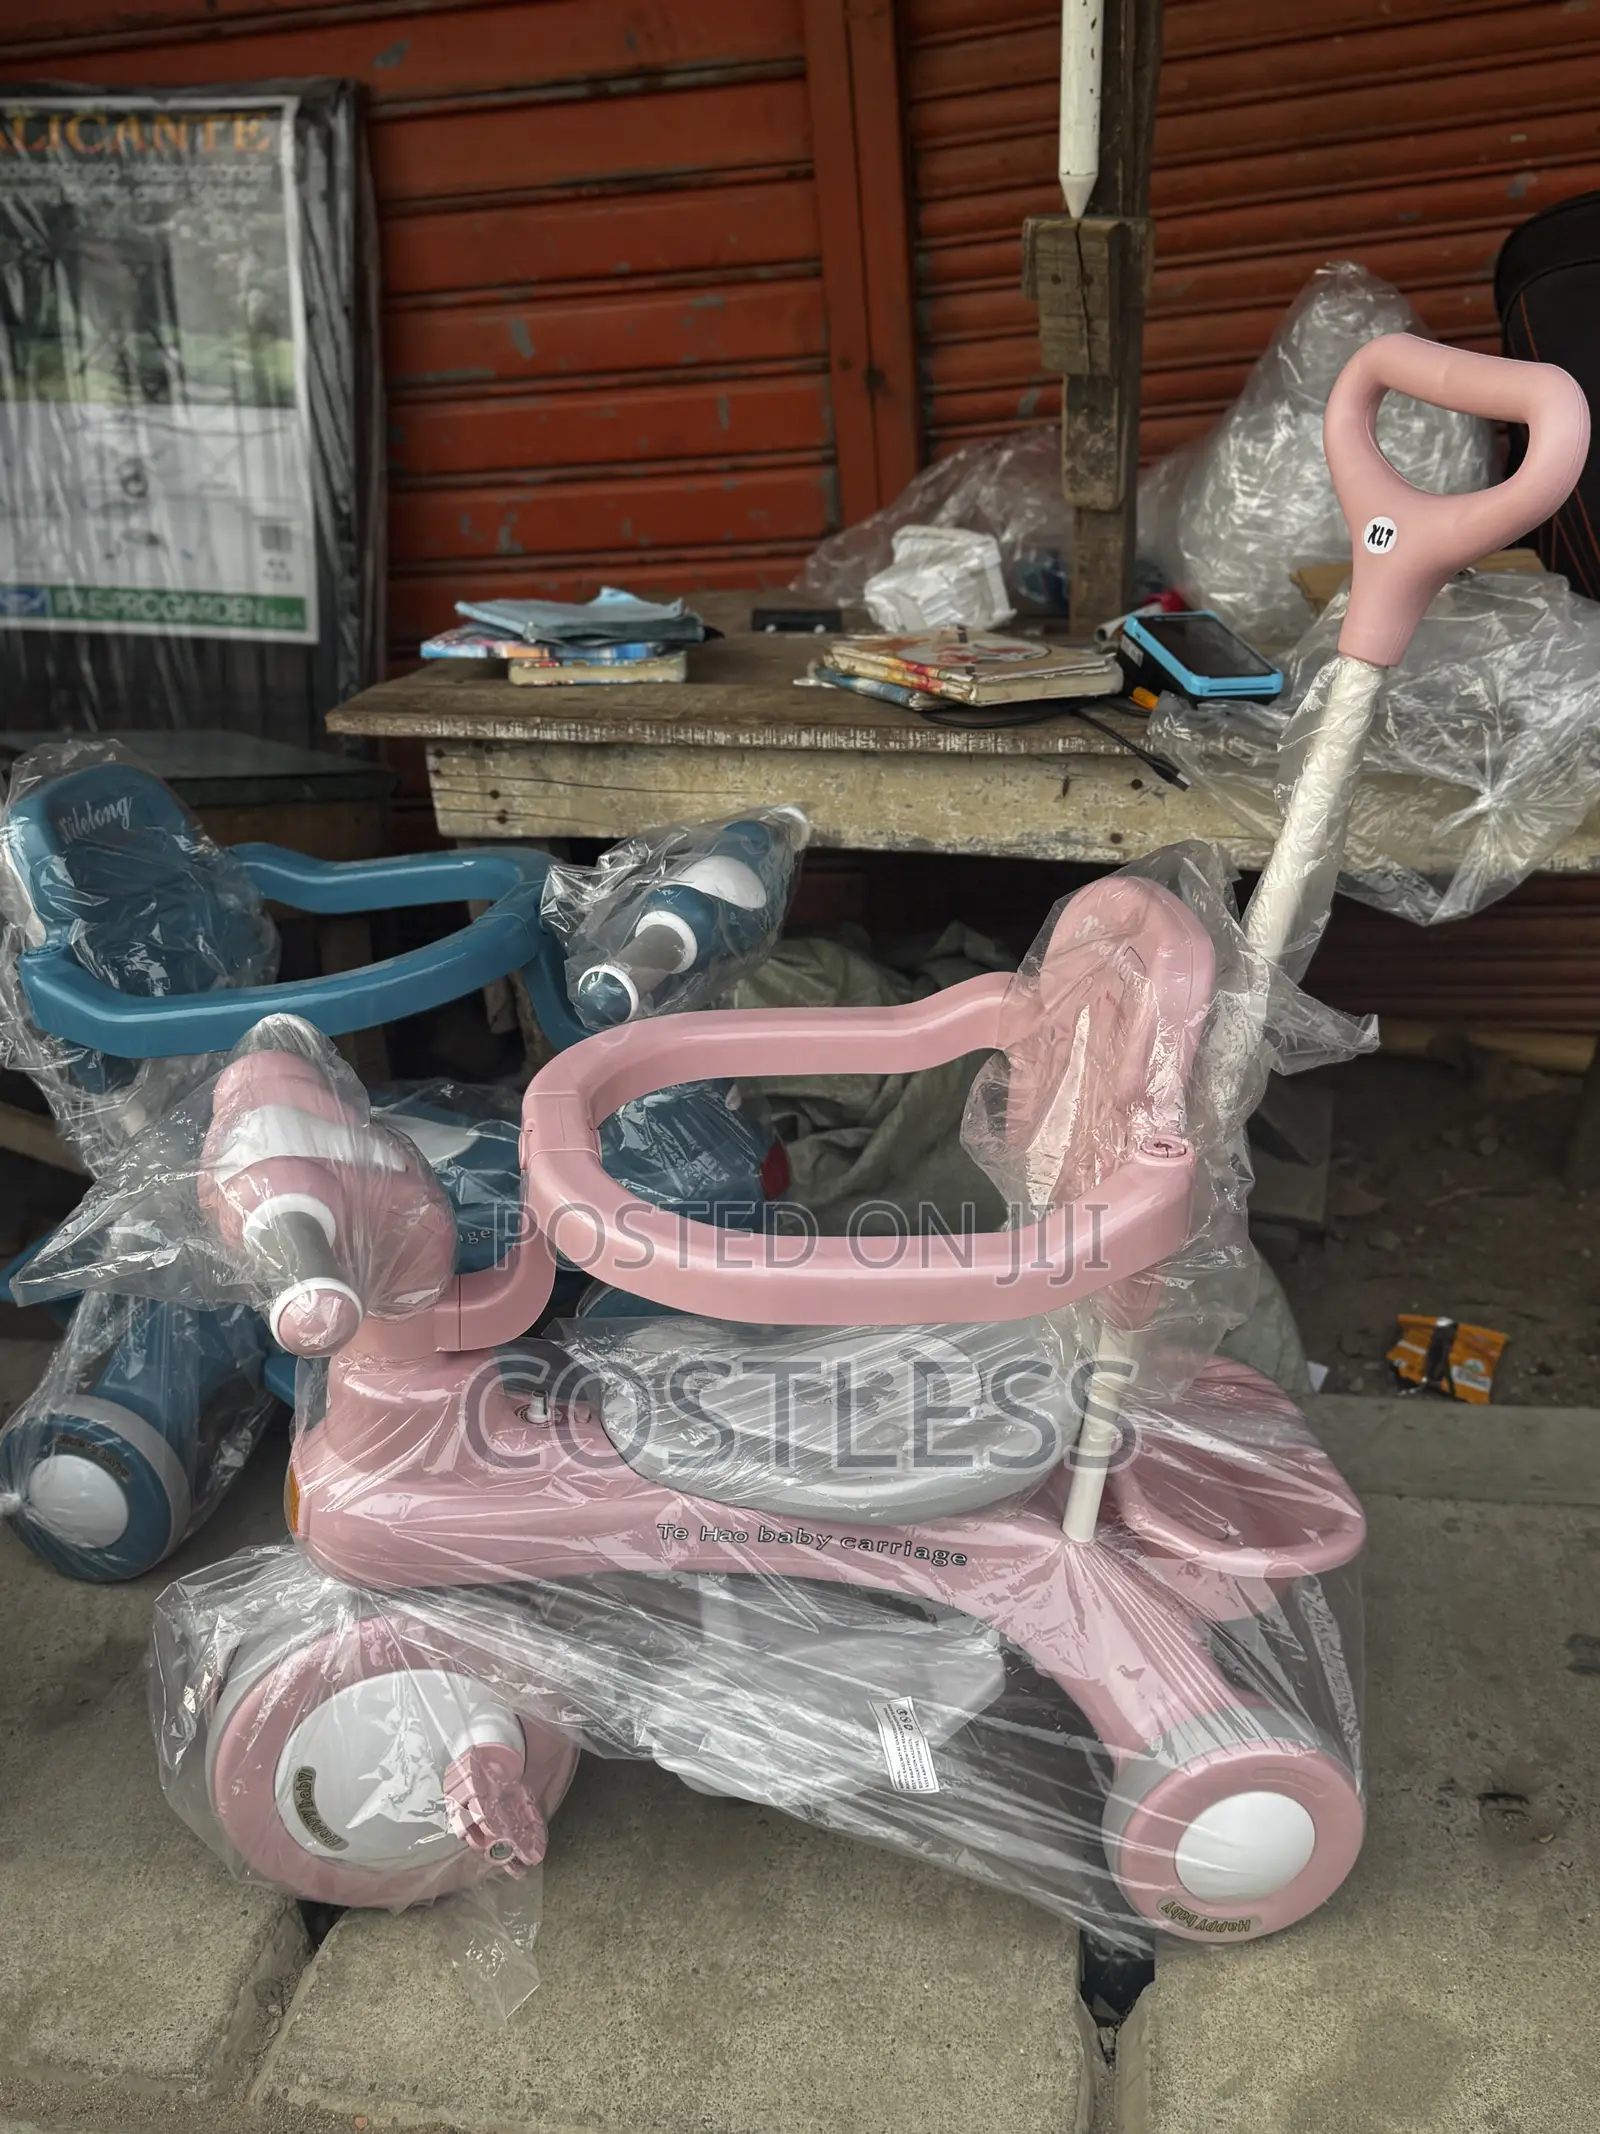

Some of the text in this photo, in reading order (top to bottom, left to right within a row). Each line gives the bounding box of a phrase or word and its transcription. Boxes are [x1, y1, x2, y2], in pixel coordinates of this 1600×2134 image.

[1367, 523, 1394, 548] XLT
[657, 1523, 968, 1567] Te Hao baby carriage
[296, 1771, 314, 1809] baby
[1161, 1901, 1251, 1933] Happy baby
